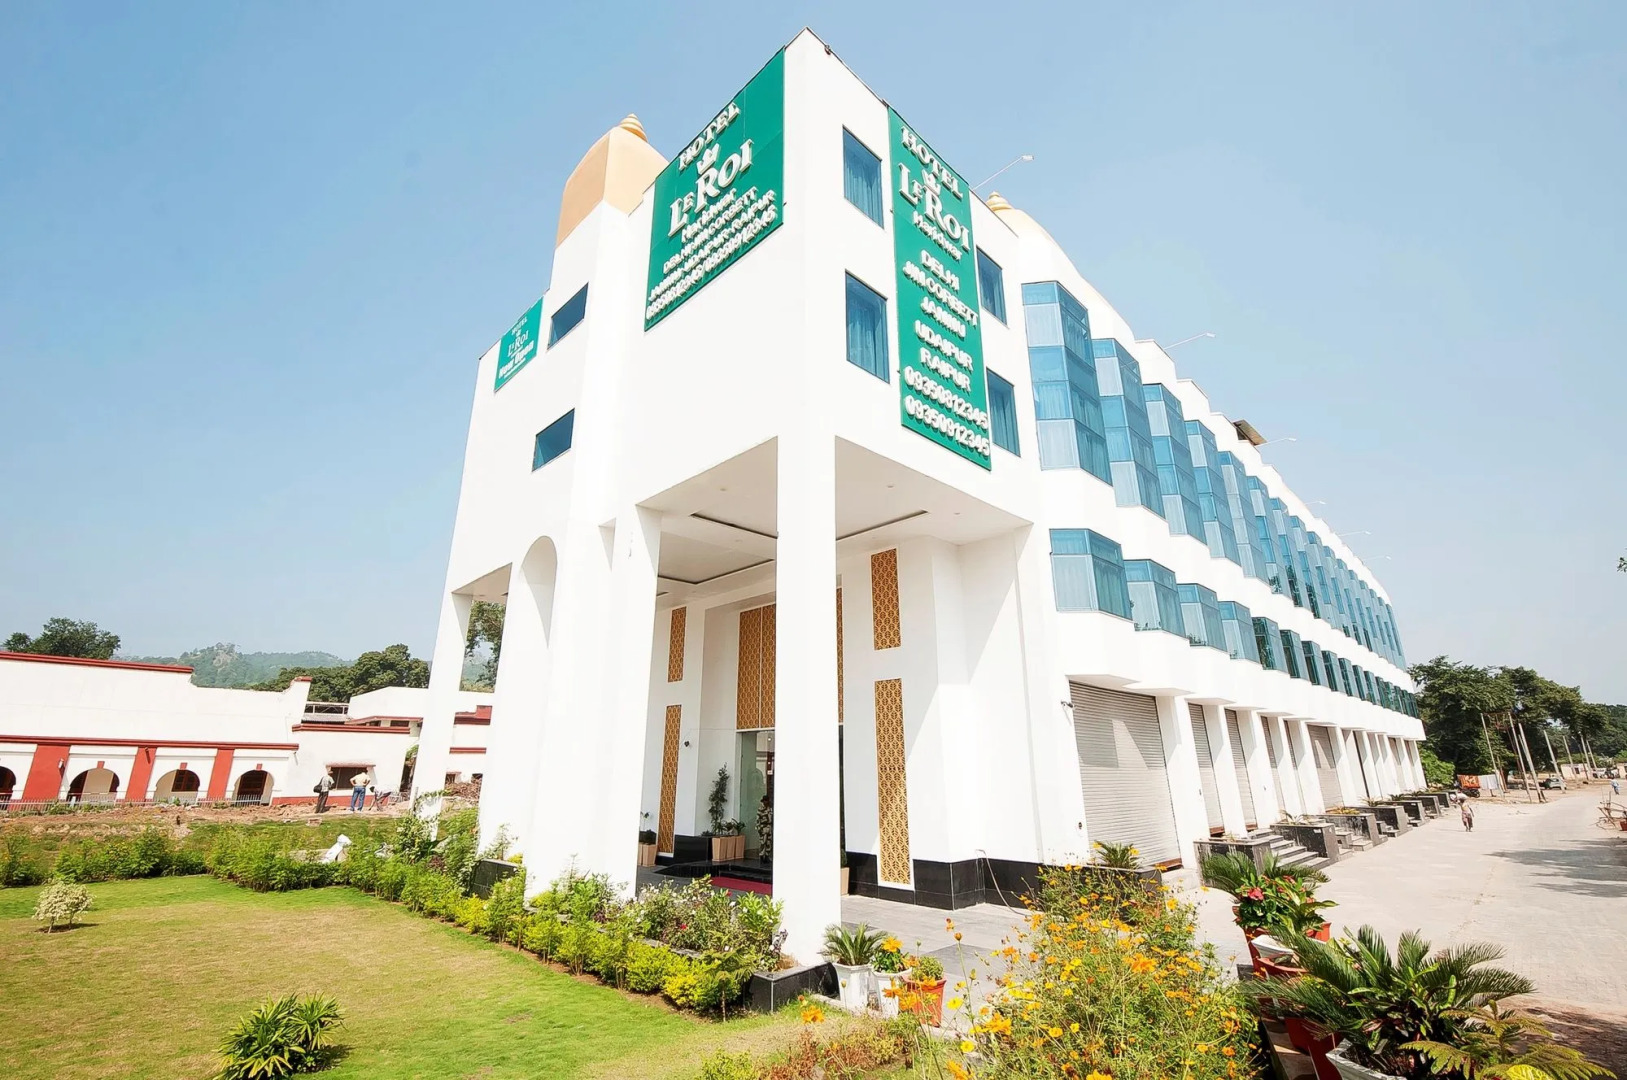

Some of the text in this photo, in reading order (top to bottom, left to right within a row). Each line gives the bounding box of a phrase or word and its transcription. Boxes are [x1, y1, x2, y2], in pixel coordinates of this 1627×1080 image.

[679, 101, 740, 171] HOTEL
[901, 125, 963, 199] HOTEL
[708, 186, 759, 236] CORBETT
[921, 249, 959, 291] DELHI
[920, 296, 966, 339] JAMMU
[925, 277, 978, 327] CORBETT
[915, 319, 973, 372] UDAIPUR
[920, 347, 971, 393] RAIPUR
